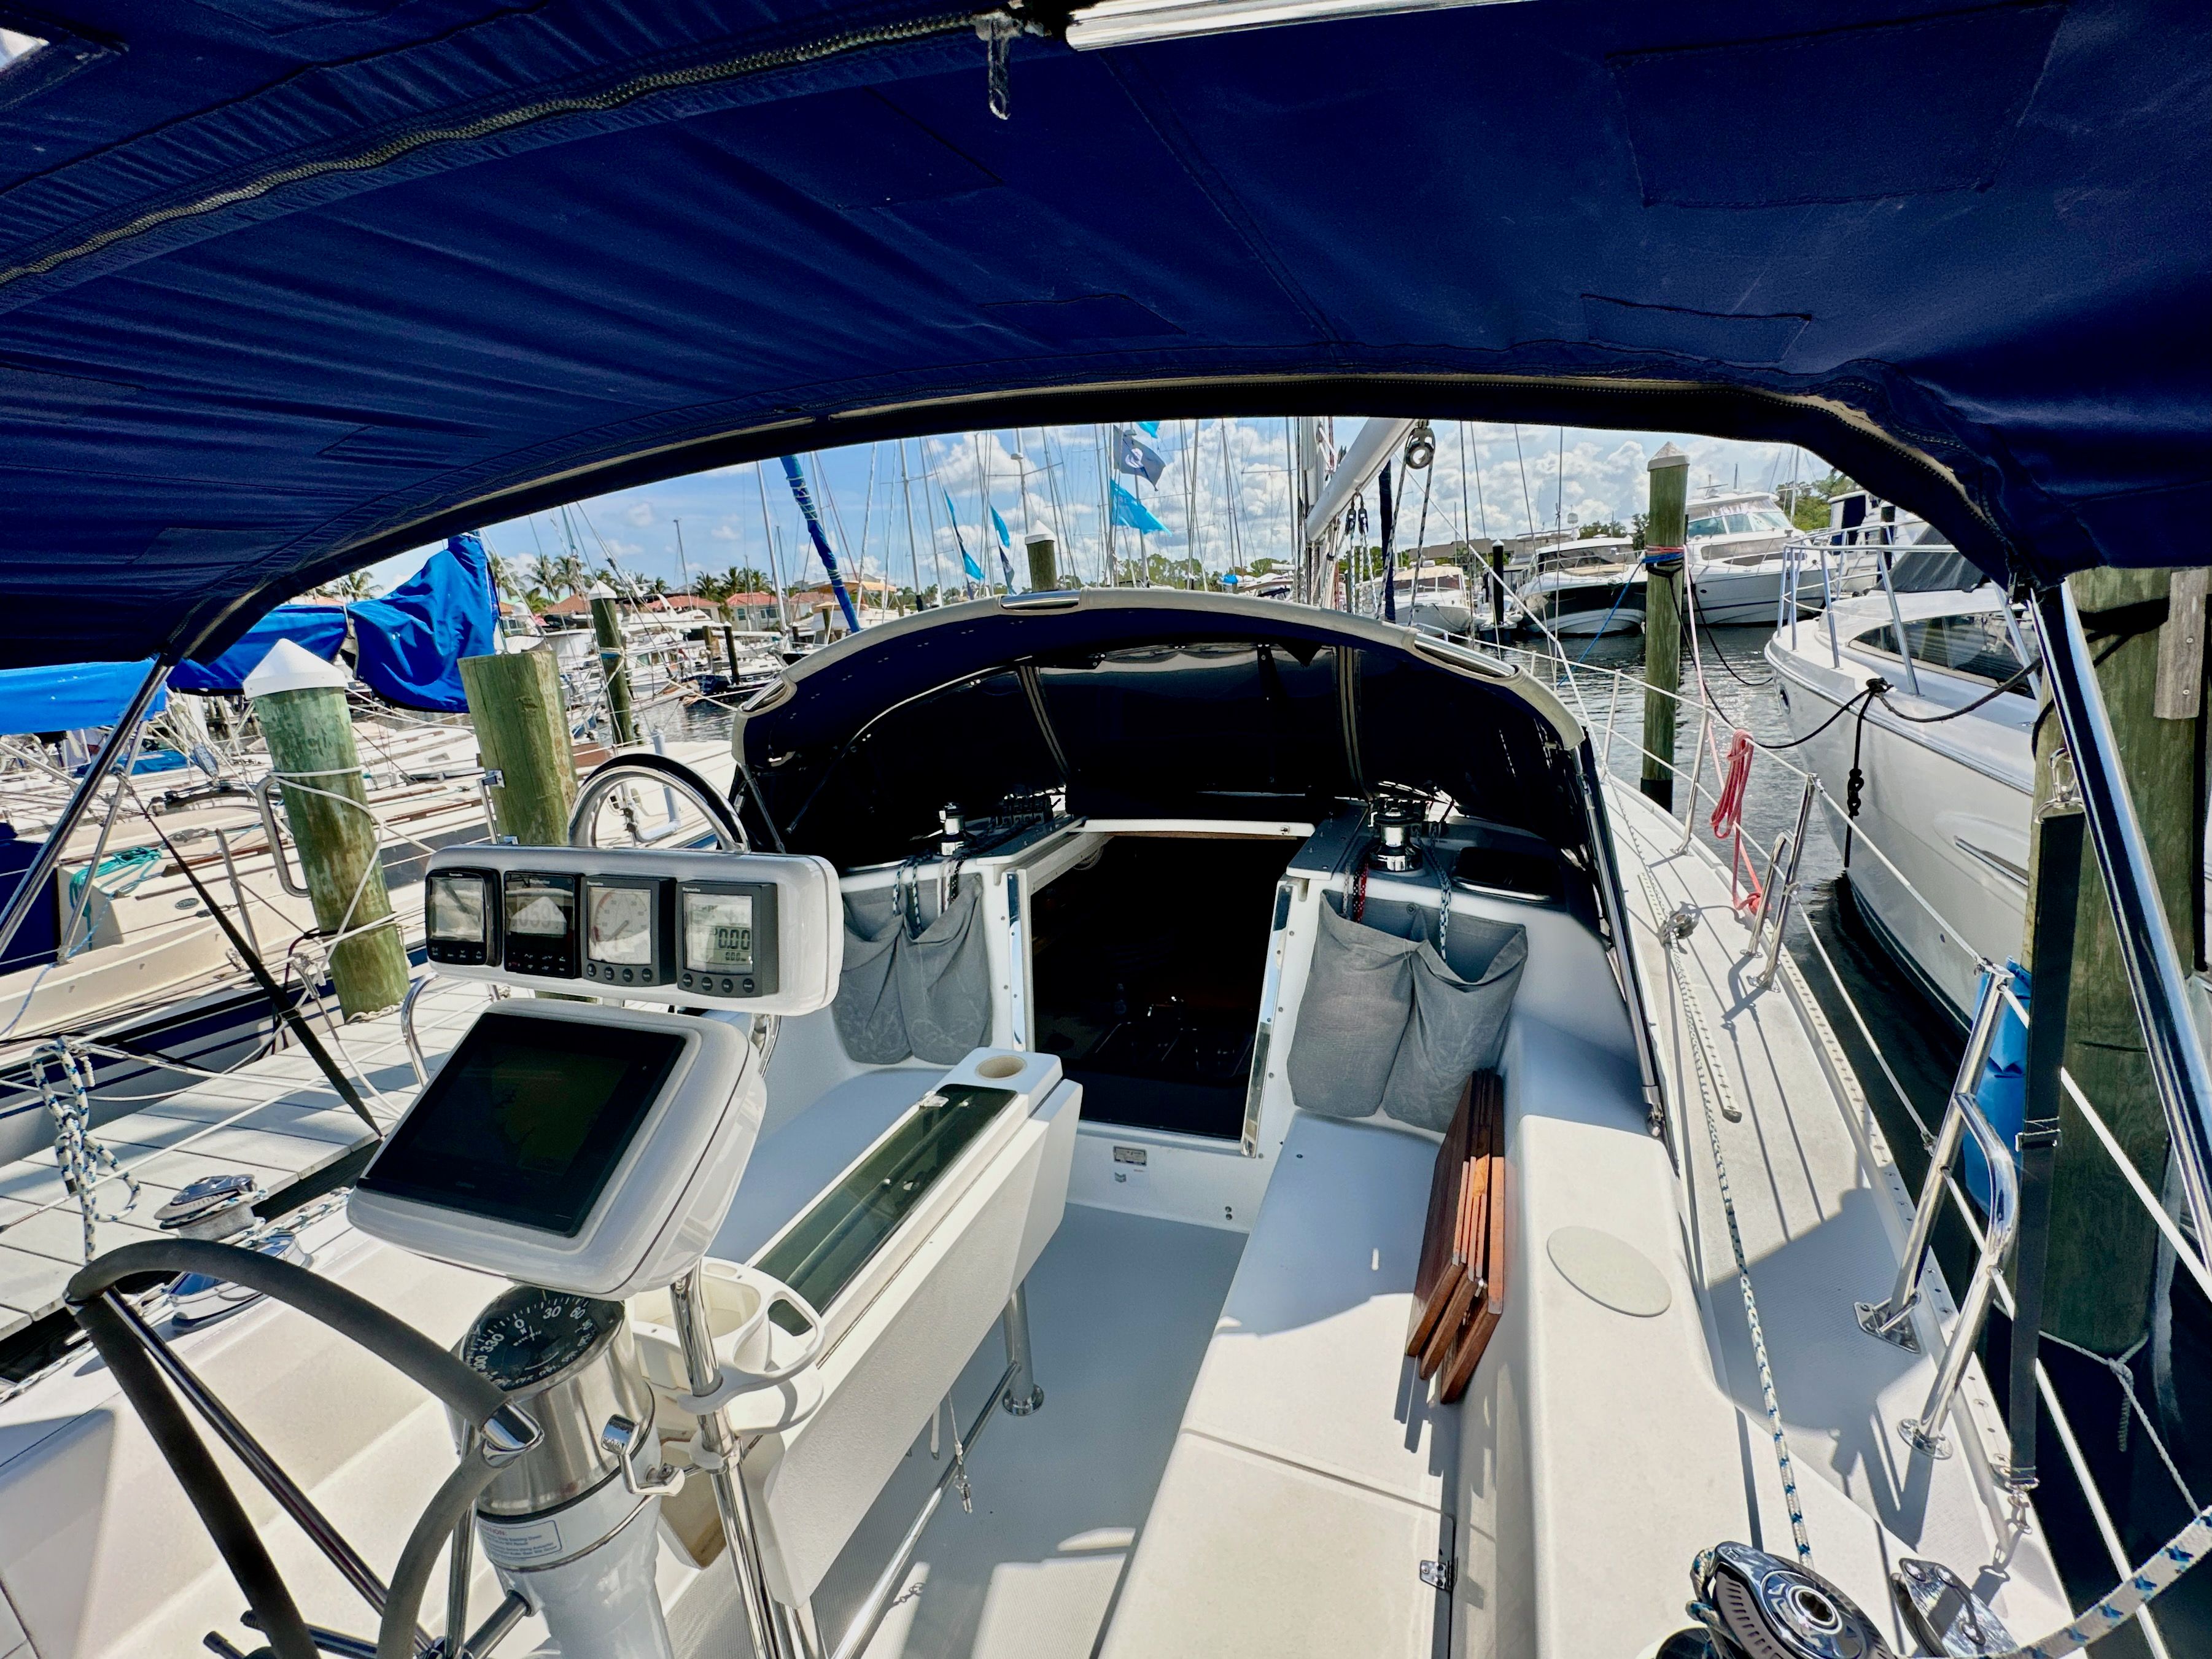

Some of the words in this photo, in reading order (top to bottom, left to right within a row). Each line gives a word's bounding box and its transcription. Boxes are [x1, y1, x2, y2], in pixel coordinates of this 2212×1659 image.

[718, 928, 751, 950] 0.00
[543, 1305, 562, 1319] 30
[570, 1307, 586, 1319] 60
[514, 1318, 525, 1329] 0
[479, 1333, 505, 1353] 330
